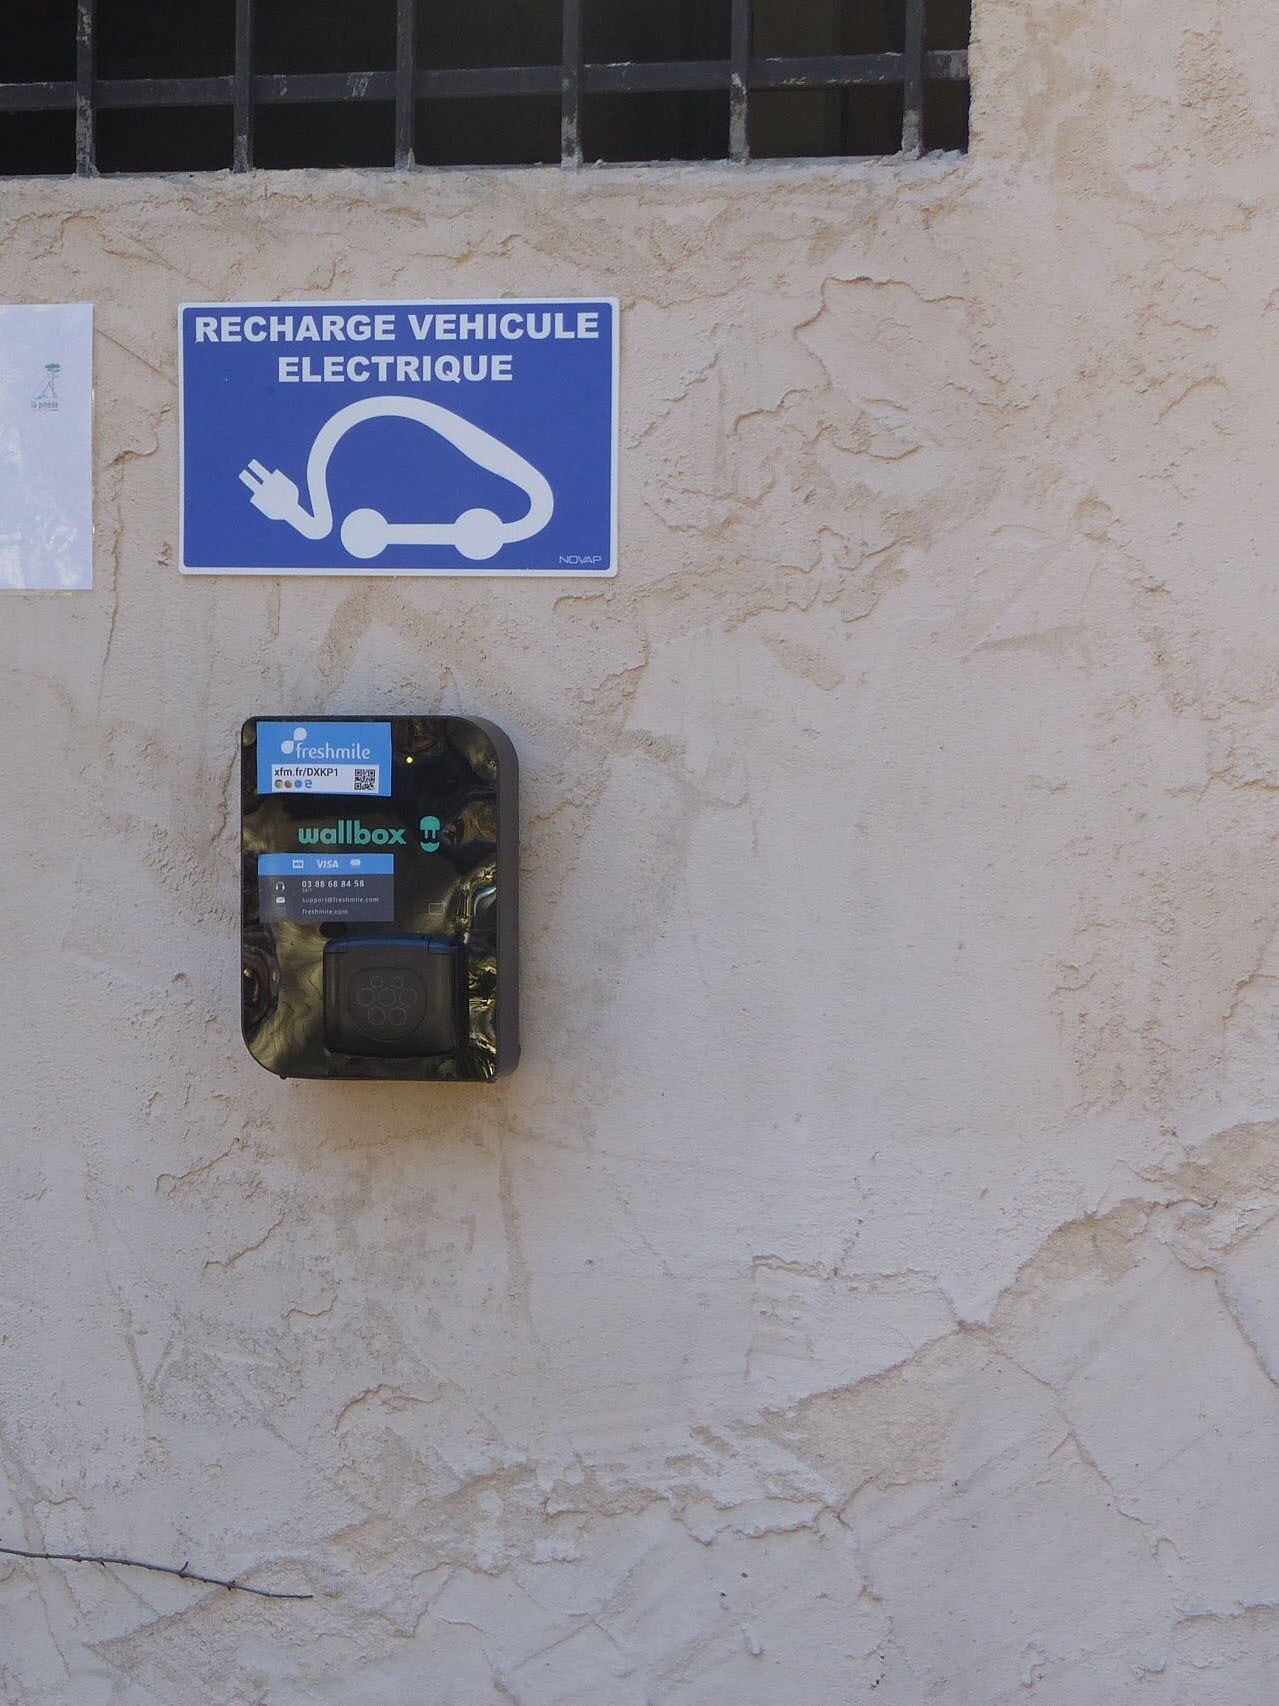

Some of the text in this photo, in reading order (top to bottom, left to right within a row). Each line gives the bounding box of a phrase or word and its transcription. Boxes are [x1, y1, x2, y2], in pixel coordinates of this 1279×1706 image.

[195, 312, 600, 343] RECHARGE VEHICULE
[278, 354, 513, 383] ELECTRIQUE
[559, 555, 602, 564] NOVAP
[296, 742, 370, 760] freshmile
[274, 767, 338, 777] xfm.fr/DXKP1
[298, 820, 407, 845] wallbox
[316, 859, 339, 869] VISA
[301, 880, 312, 888] 03
